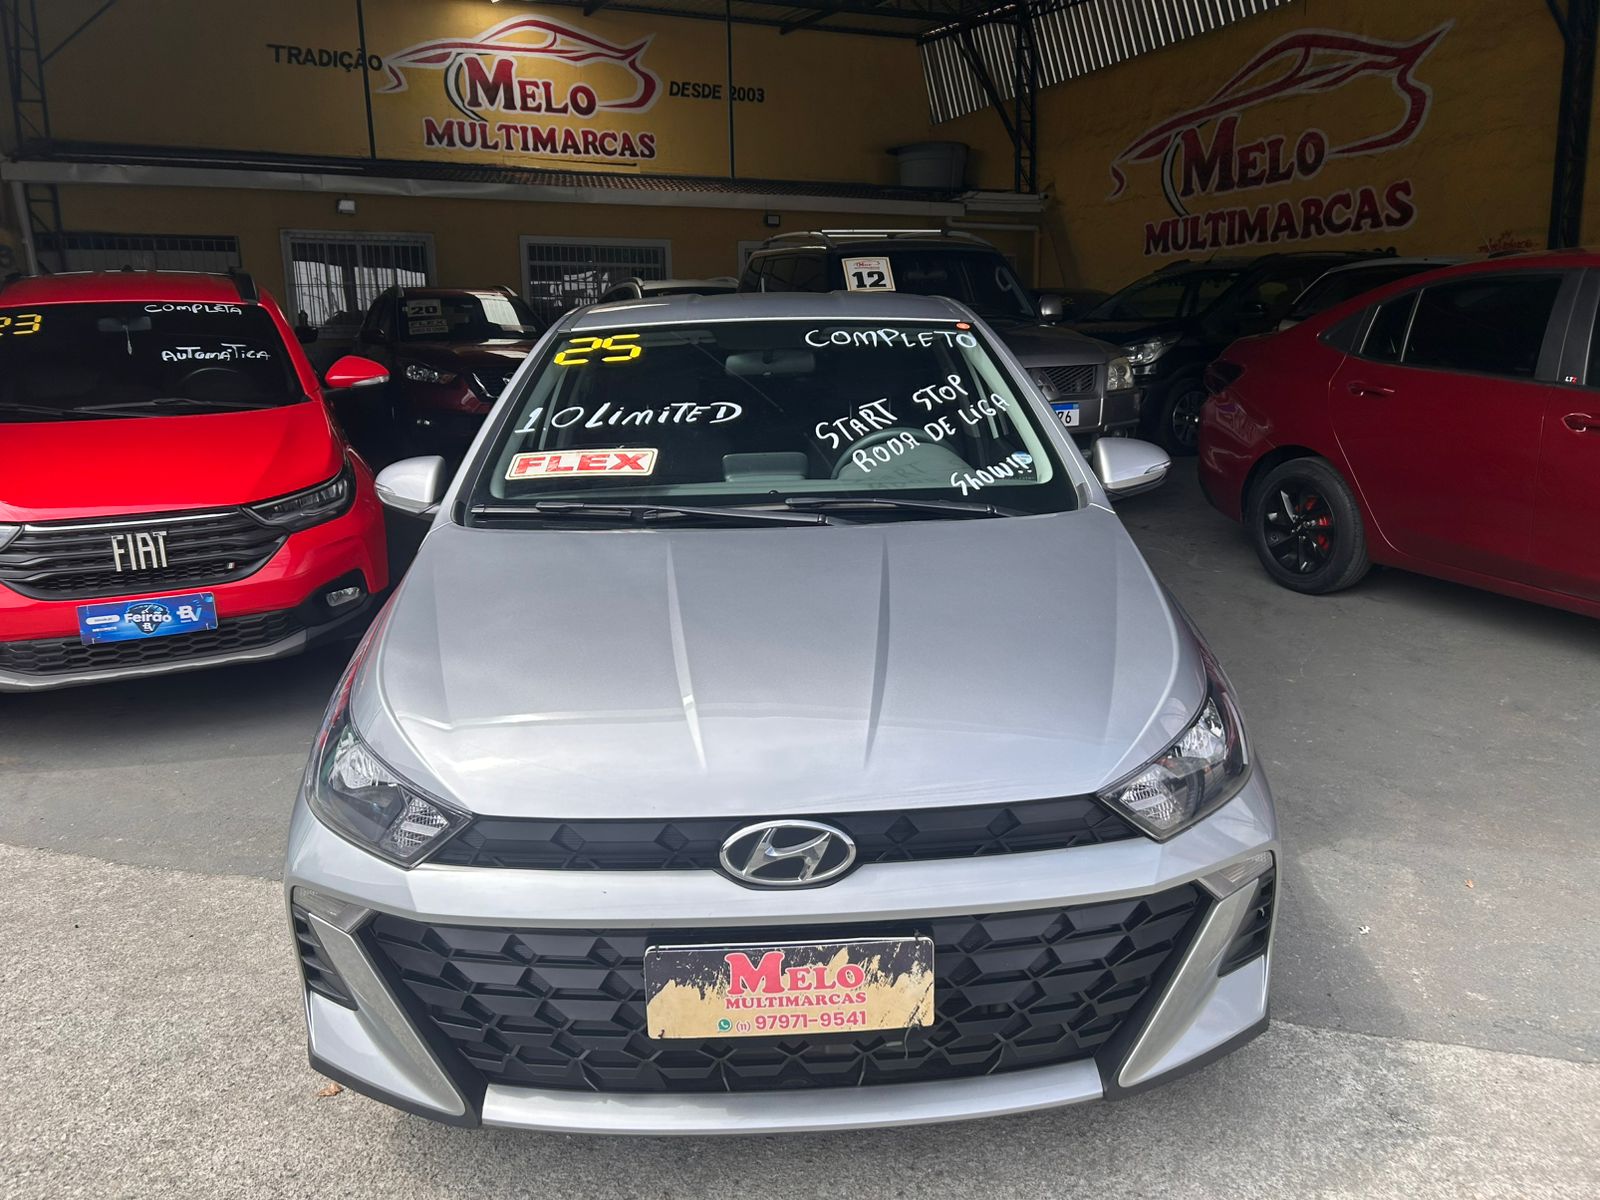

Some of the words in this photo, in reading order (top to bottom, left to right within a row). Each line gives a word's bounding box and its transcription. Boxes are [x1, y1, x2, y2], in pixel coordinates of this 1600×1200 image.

[463, 56, 598, 116] MELO
[668, 81, 722, 100] DESDE
[730, 86, 765, 103] 2003
[424, 118, 656, 159] MULTIMARCAS
[1180, 115, 1327, 197] MELO
[1144, 180, 1415, 255] MULTIMARCAS
[852, 271, 887, 288] 12
[553, 334, 642, 366] 25
[805, 328, 977, 348] COMPLETO
[514, 406, 584, 433] 1.0
[815, 398, 898, 449] START
[912, 374, 968, 411] STOP
[852, 431, 921, 473] RODA
[924, 416, 956, 441] DE
[514, 453, 650, 475] FLEX
[111, 531, 168, 572] FIAT
[124, 611, 172, 623] Feirão
[724, 951, 866, 995] MELO
[725, 992, 867, 1010] MULTIMARCAS
[755, 1011, 867, 1030] 97971-9541
